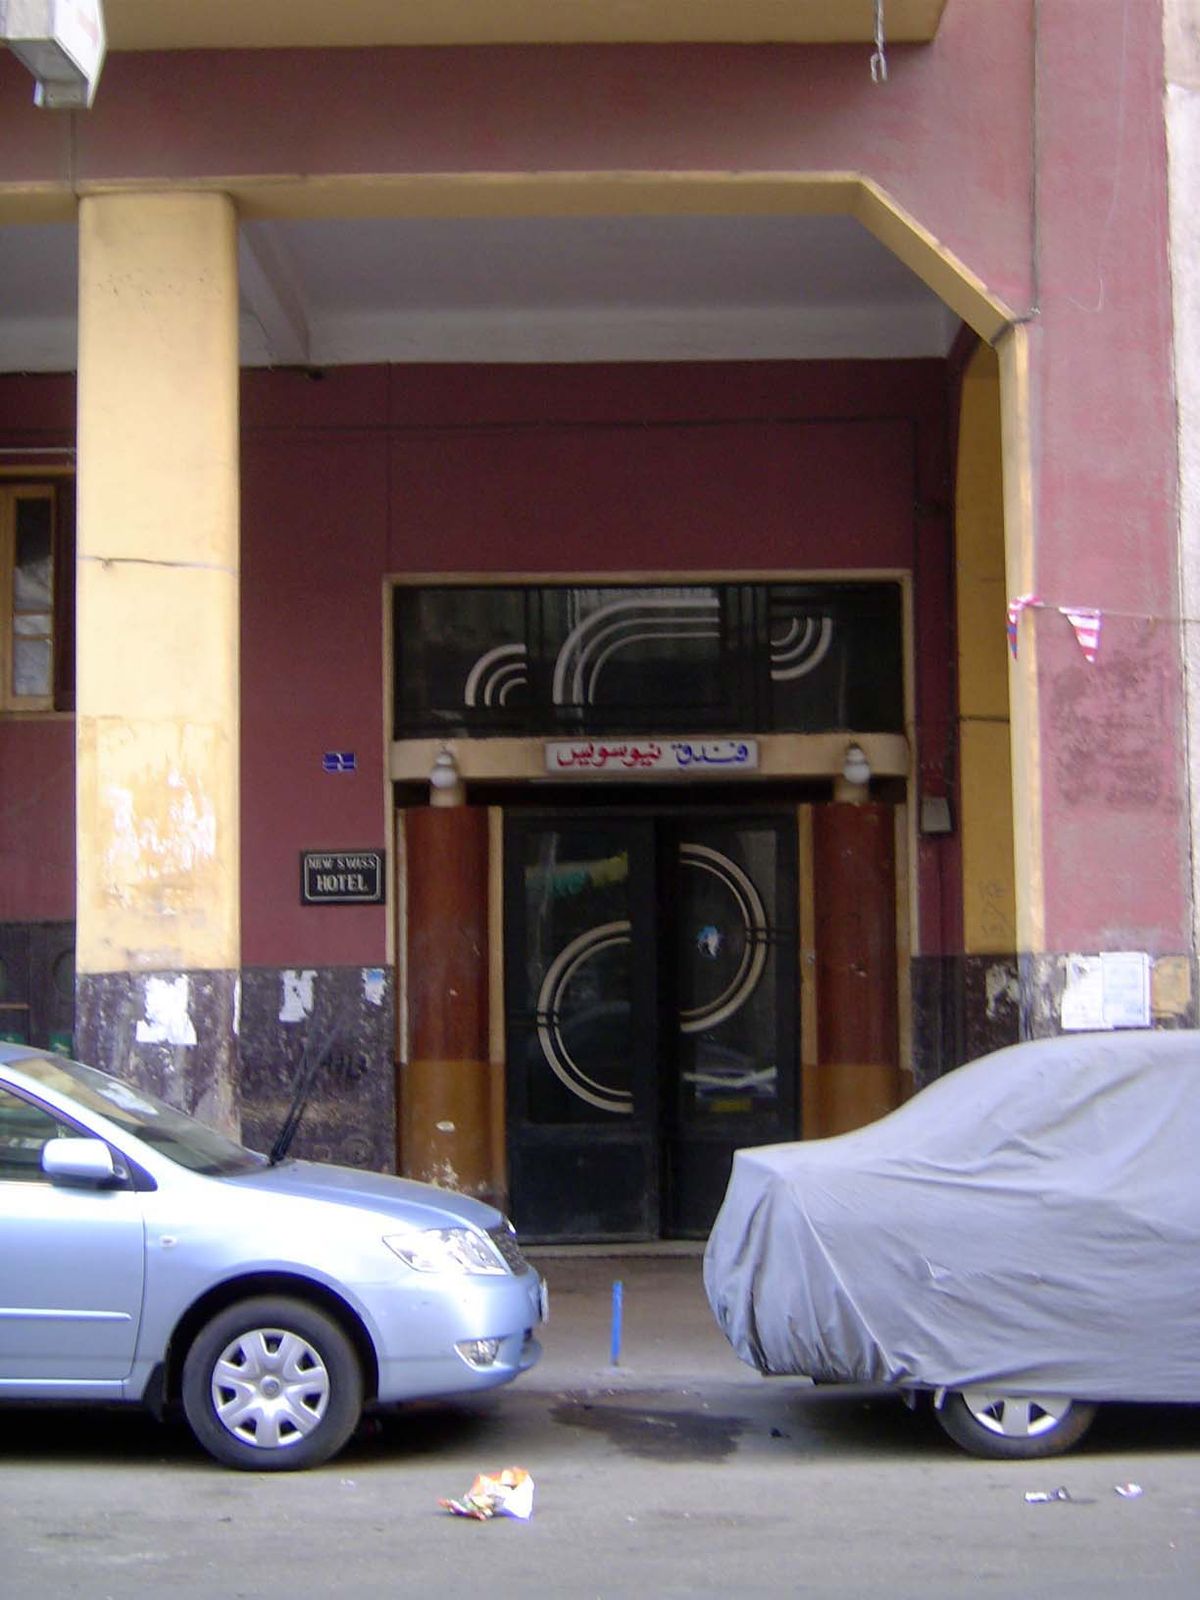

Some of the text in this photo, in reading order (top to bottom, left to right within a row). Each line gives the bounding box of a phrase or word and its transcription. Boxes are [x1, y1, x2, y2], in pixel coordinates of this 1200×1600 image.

[671, 742, 749, 765] فندق
[308, 856, 376, 869] NEW SWISS
[316, 874, 369, 892] HOTEL
